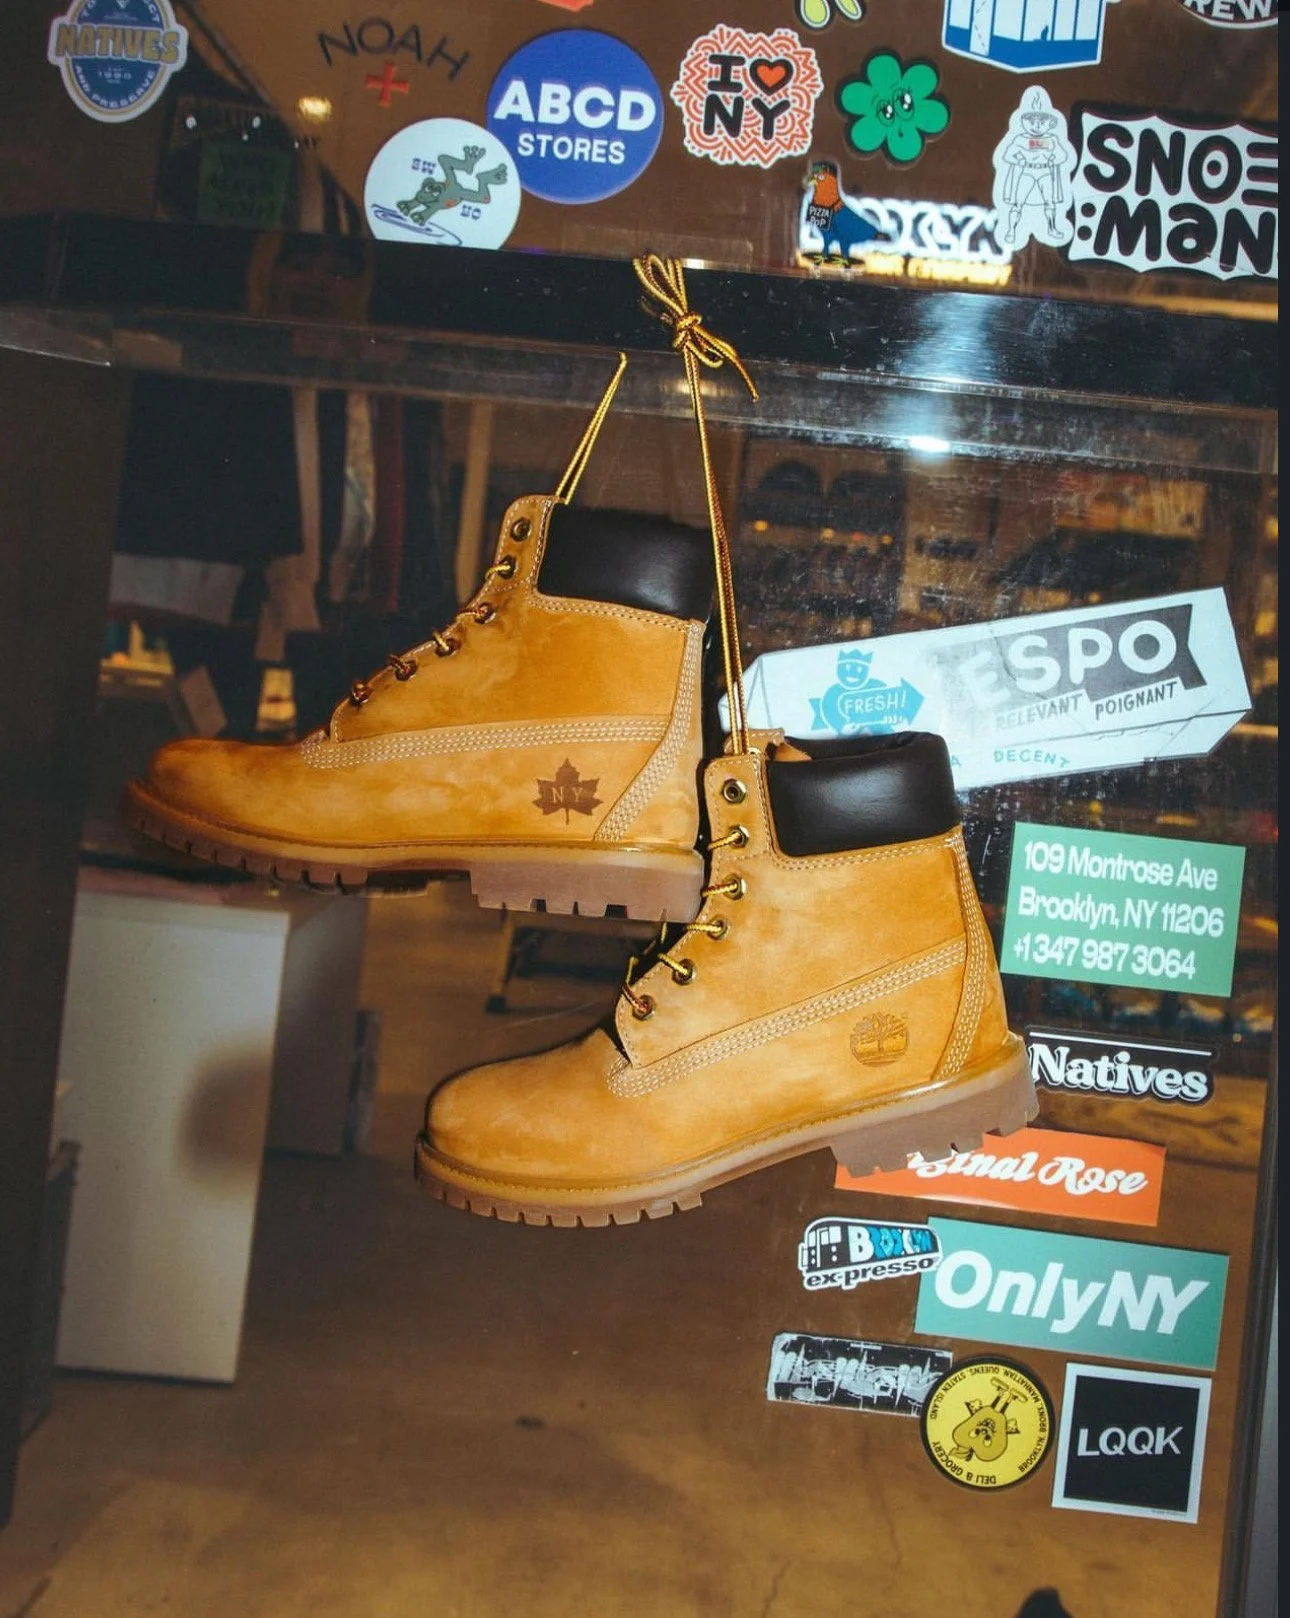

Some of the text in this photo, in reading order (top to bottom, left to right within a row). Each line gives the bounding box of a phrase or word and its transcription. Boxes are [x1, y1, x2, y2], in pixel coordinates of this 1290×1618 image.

[55, 23, 180, 64] NATIVES
[317, 17, 470, 81] NOAH
[707, 54, 746, 94] I
[494, 80, 656, 132] ABCD
[703, 94, 790, 141] NY
[517, 133, 626, 164] STORES
[809, 206, 829, 217] PIZZA
[958, 619, 1177, 702] ESPO
[844, 690, 907, 714] FRESH!
[996, 693, 1083, 731] RELEVANT
[1095, 681, 1177, 720] POIGNANT
[994, 748, 1070, 769] DECENT
[1024, 840, 1217, 891] 109 Montrose Ave
[1018, 886, 1224, 938] Brooklyn, NY 11206
[1033, 934, 1079, 966] 347
[1082, 938, 1129, 972] 987
[1131, 944, 1195, 980] 3064
[1028, 1043, 1208, 1101] Natives
[1037, 1156, 1148, 1195] Rose
[806, 1258, 934, 1287] ex-presso
[932, 1441, 964, 1476] GROCERY
[1077, 1426, 1184, 1457] LQQK
[975, 1475, 997, 1485] DELI
